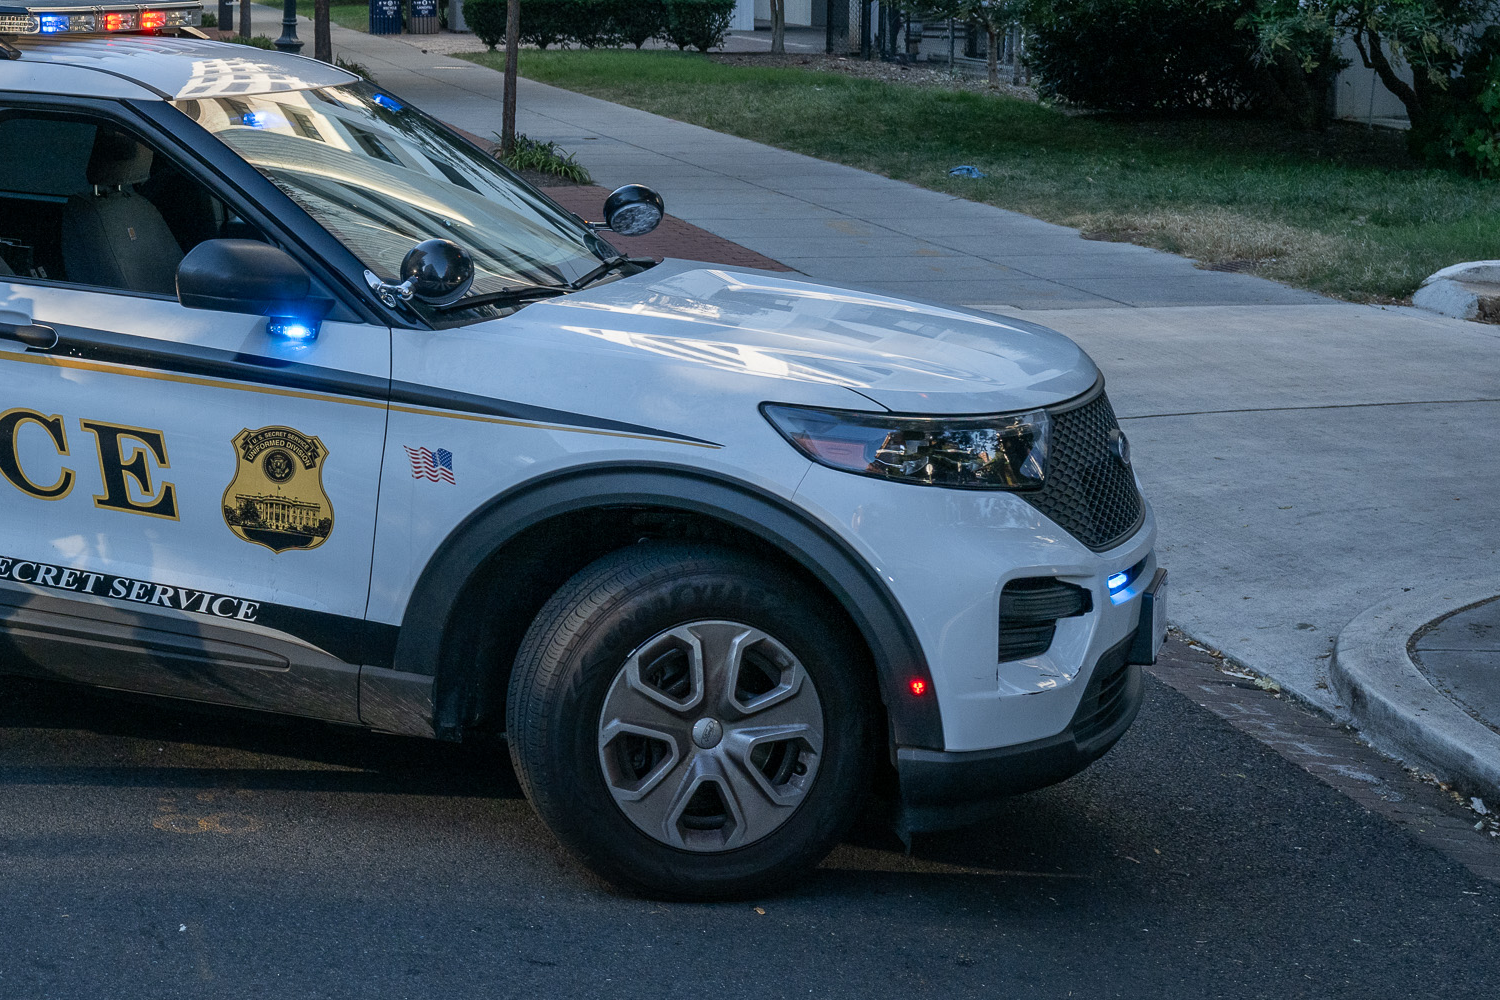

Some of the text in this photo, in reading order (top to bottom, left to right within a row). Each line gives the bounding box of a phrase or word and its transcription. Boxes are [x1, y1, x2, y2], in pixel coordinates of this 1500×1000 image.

[248, 439, 311, 466] UNIFORMED DIVISION
[287, 433, 310, 449] SERVICE
[108, 577, 260, 622] SERVICE
